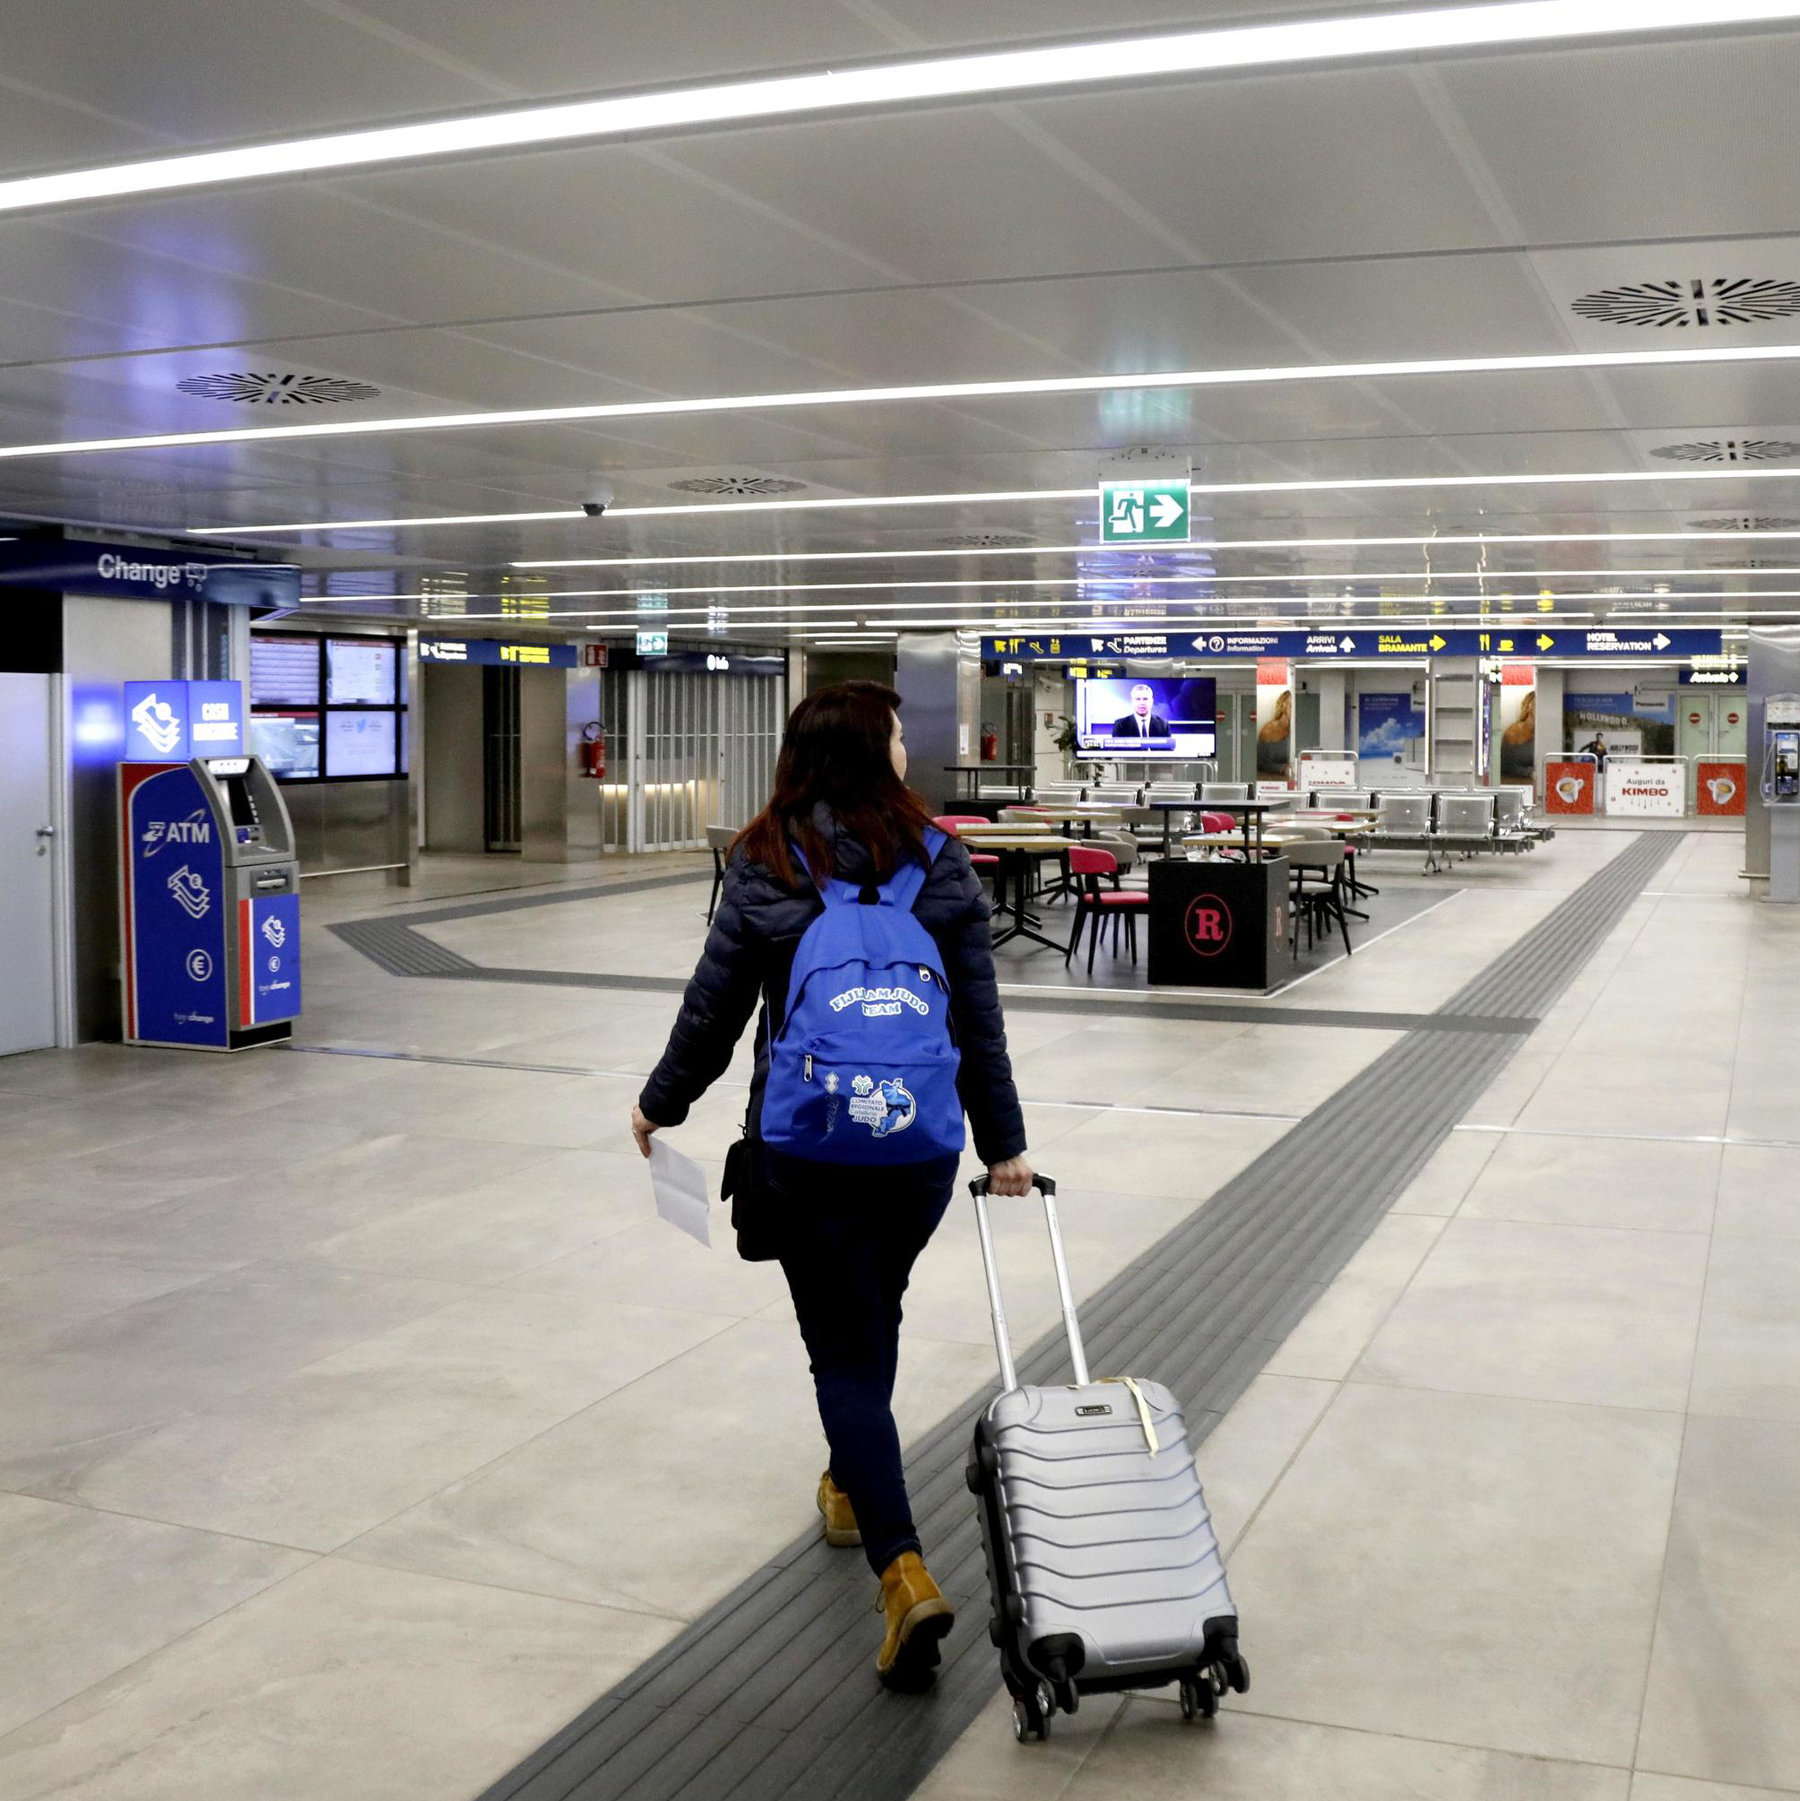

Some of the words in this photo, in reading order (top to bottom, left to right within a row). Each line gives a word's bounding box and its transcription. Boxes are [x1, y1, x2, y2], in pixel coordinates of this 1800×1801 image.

[97, 553, 181, 588] Change
[1123, 636, 1167, 645] PARTENZE
[1226, 637, 1279, 645] INFORMAZIONI
[1306, 636, 1336, 644] ARRIVI
[1378, 635, 1402, 643] SALA
[1586, 633, 1618, 642] HOTEL
[1123, 646, 1168, 654] Departures
[1226, 645, 1265, 653] Information
[1306, 645, 1338, 653] Arrivals
[1378, 643, 1428, 652] BRAMANTE
[1586, 642, 1652, 651] RESERVATION
[1579, 711, 1628, 726] HOLLYWOOD
[1626, 778, 1653, 786] Auguri
[1622, 788, 1669, 796] KIMBO
[166, 822, 210, 843] ATM
[1195, 908, 1224, 941] R
[891, 987, 929, 1015] JUDO
[862, 1002, 902, 1017] TEAM
[851, 1104, 885, 1112] REGIONALE
[853, 1115, 877, 1123] JUDO
